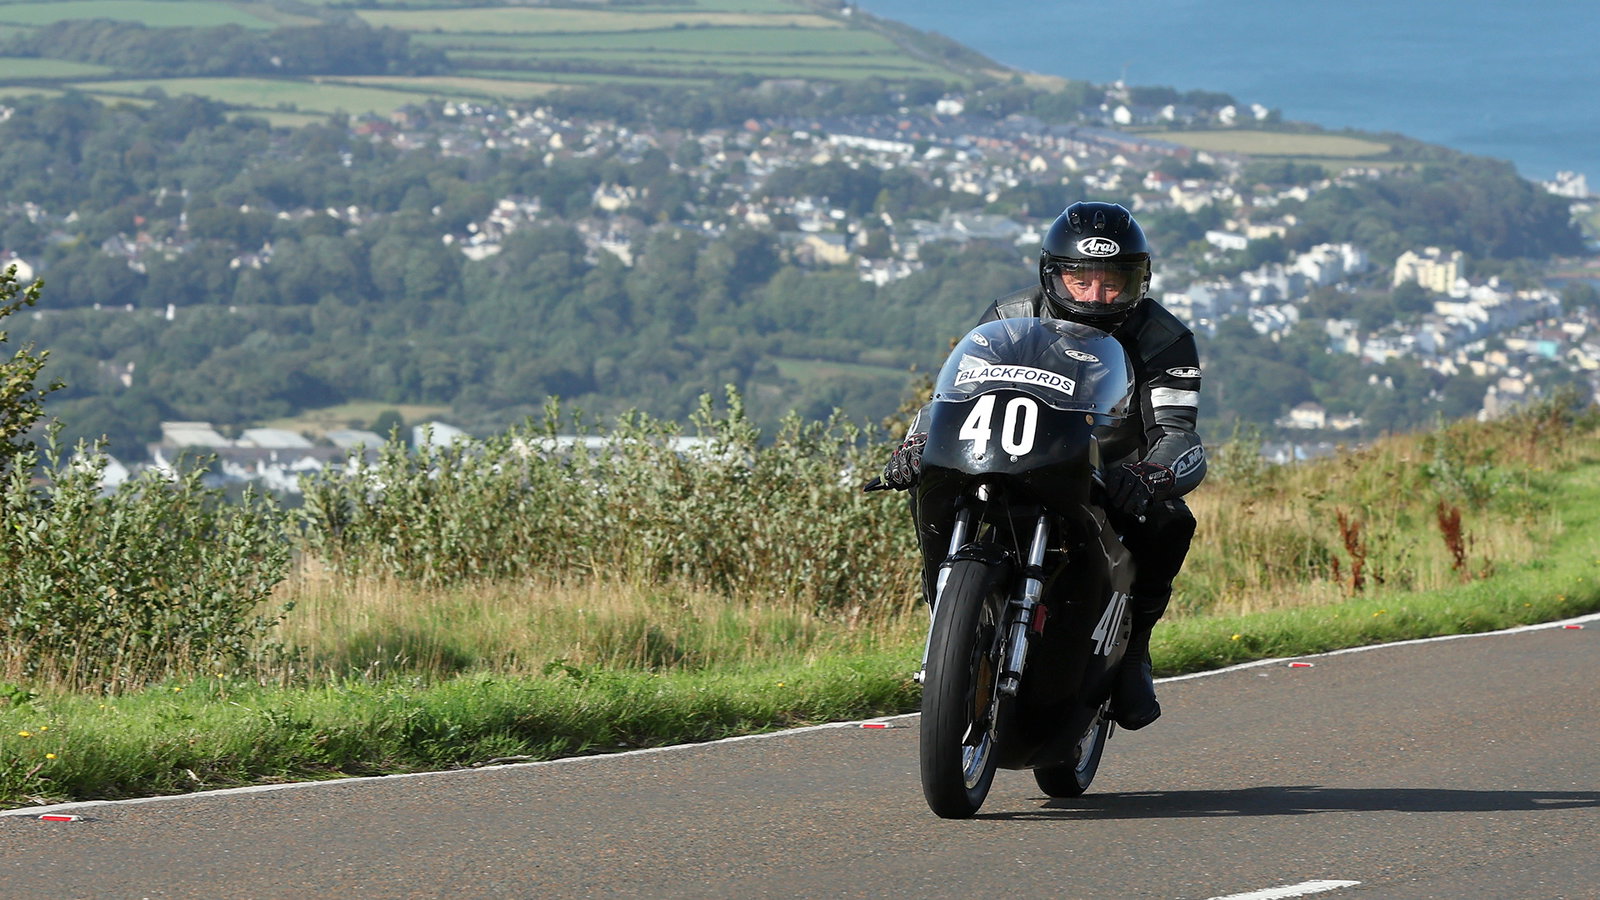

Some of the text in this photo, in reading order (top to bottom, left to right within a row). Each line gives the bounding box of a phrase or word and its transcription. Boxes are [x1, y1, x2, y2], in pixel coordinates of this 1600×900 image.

[1084, 239, 1116, 252] Arai
[958, 367, 1073, 391] BLACKFORDS
[958, 394, 1039, 457] 40
[1091, 591, 1127, 656] 40
